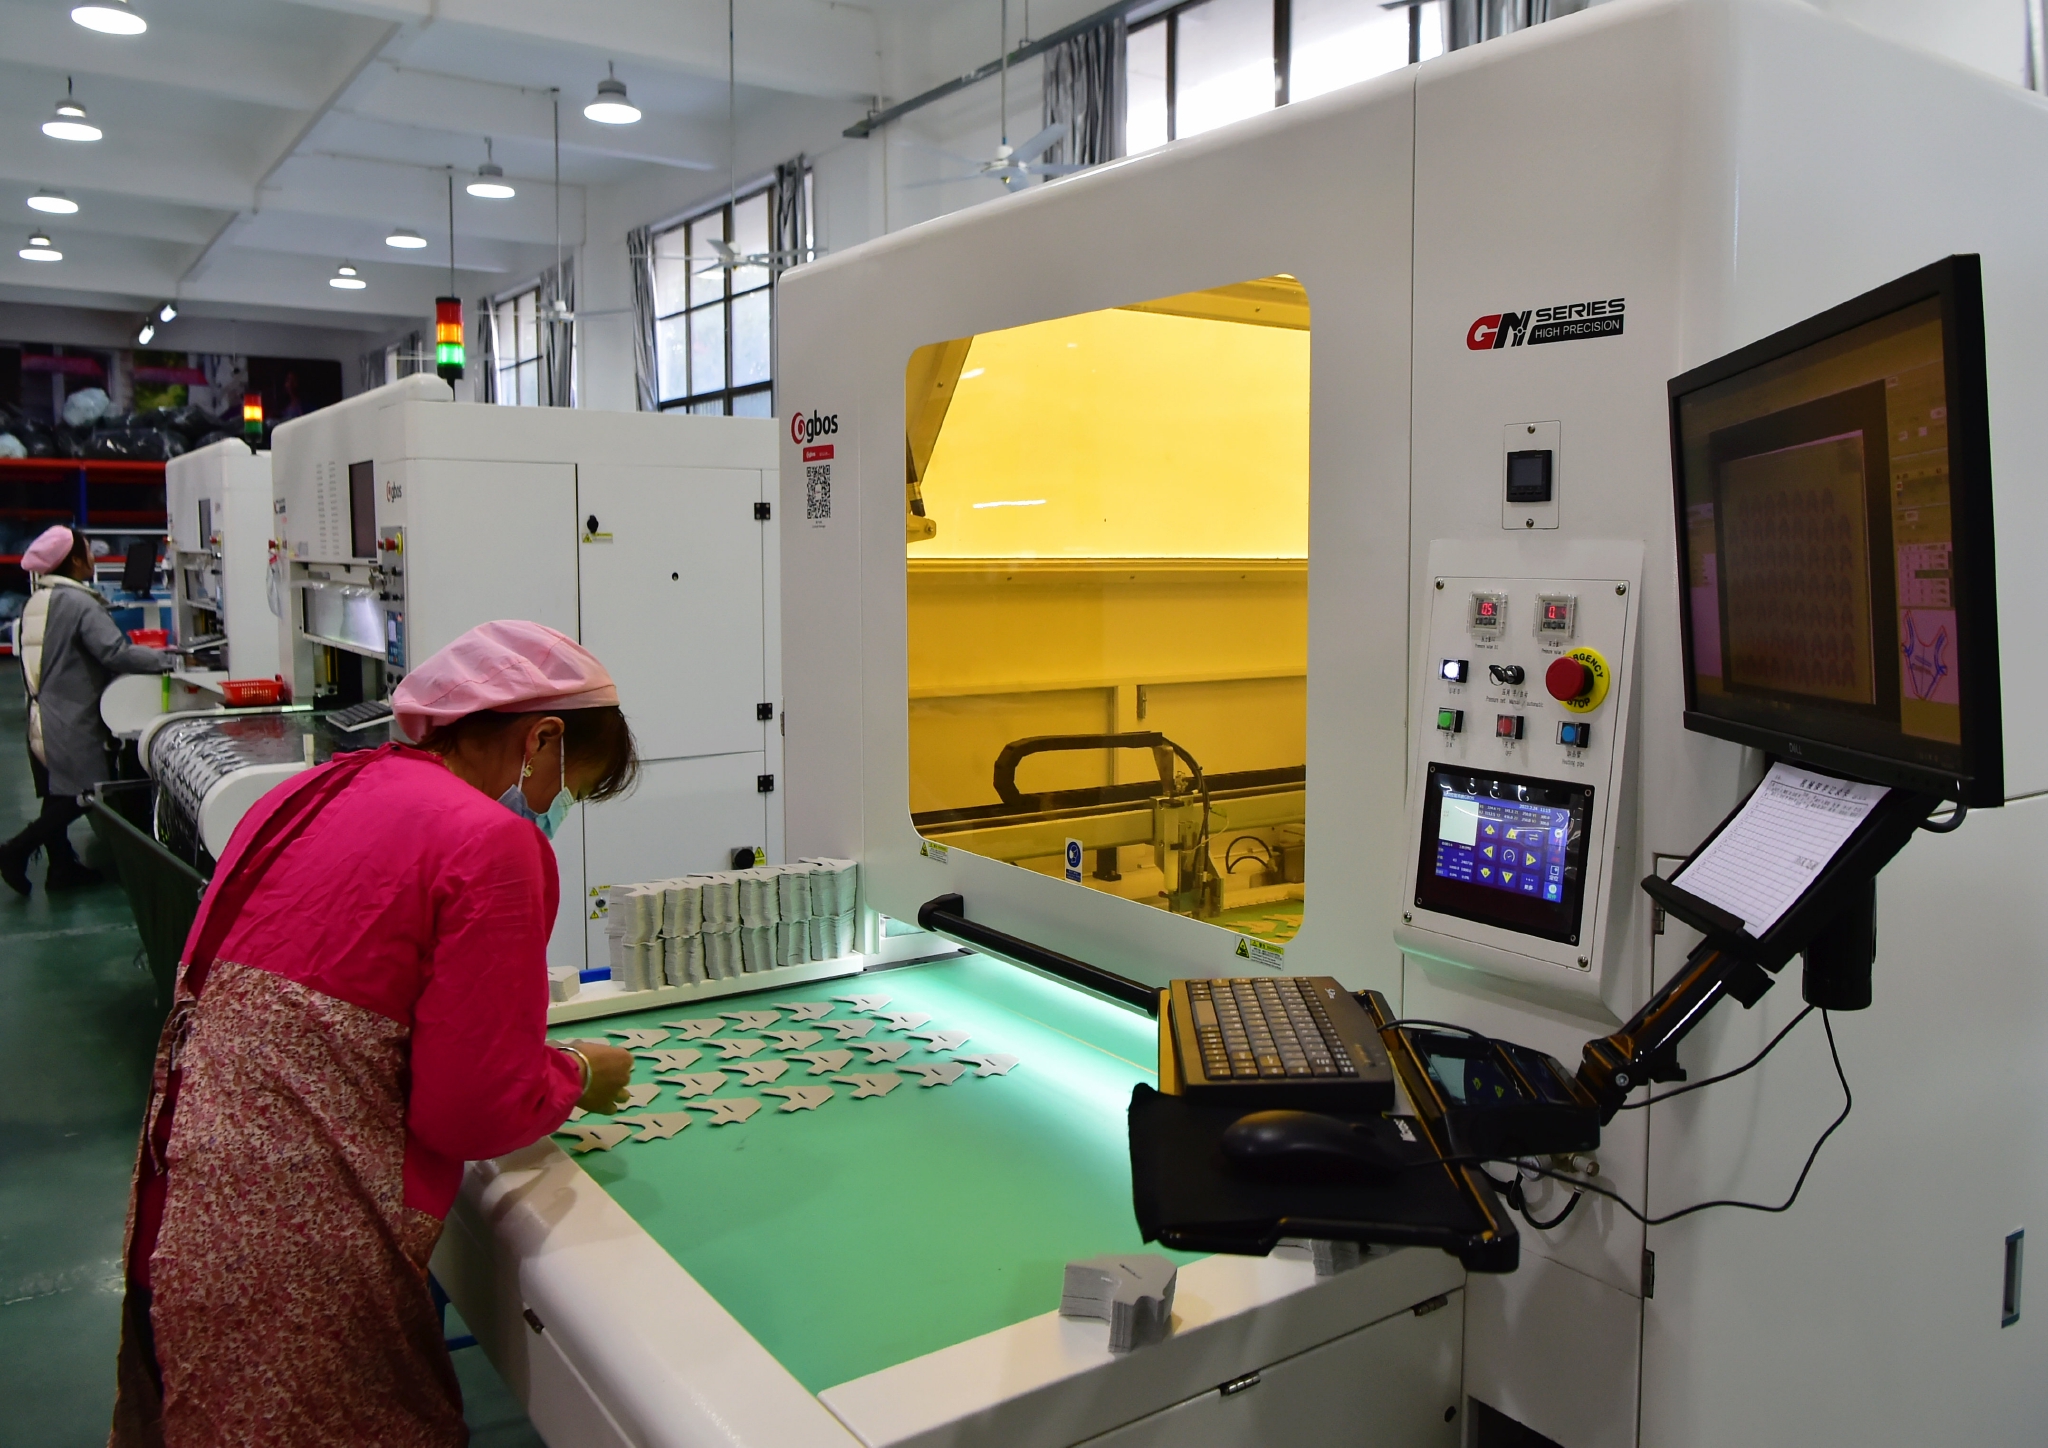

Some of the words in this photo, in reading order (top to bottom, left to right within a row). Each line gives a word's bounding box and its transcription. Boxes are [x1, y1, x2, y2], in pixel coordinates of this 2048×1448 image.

[1535, 298, 1625, 323] SERIES
[1535, 325, 1560, 339] HIGH
[1563, 319, 1620, 336] PRECISION
[805, 409, 838, 443] gbos
[1573, 653, 1604, 678] RGENCY
[1567, 697, 1591, 708] STOP
